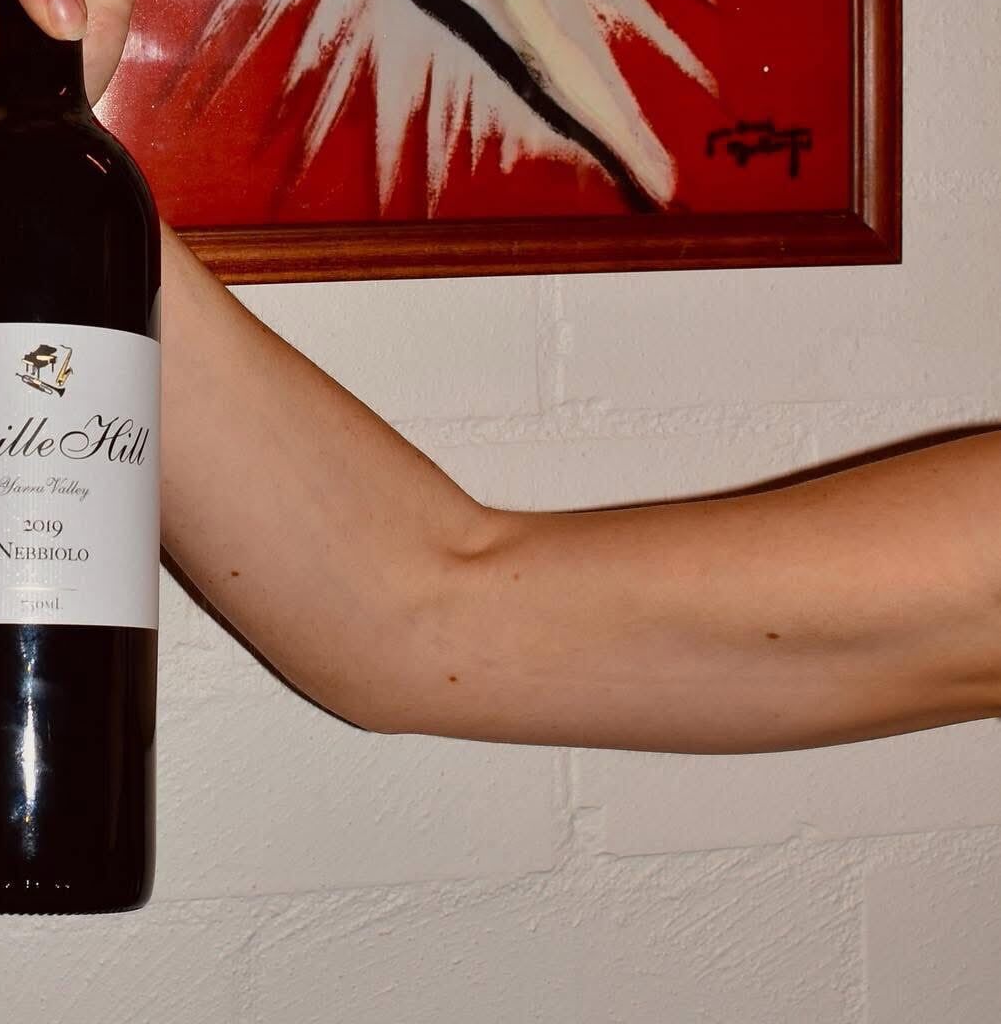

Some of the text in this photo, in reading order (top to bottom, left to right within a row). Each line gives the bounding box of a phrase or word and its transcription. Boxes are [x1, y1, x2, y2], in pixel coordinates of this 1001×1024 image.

[59, 414, 150, 466] Hill
[46, 477, 90, 502] Valley
[22, 519, 64, 538] 2019
